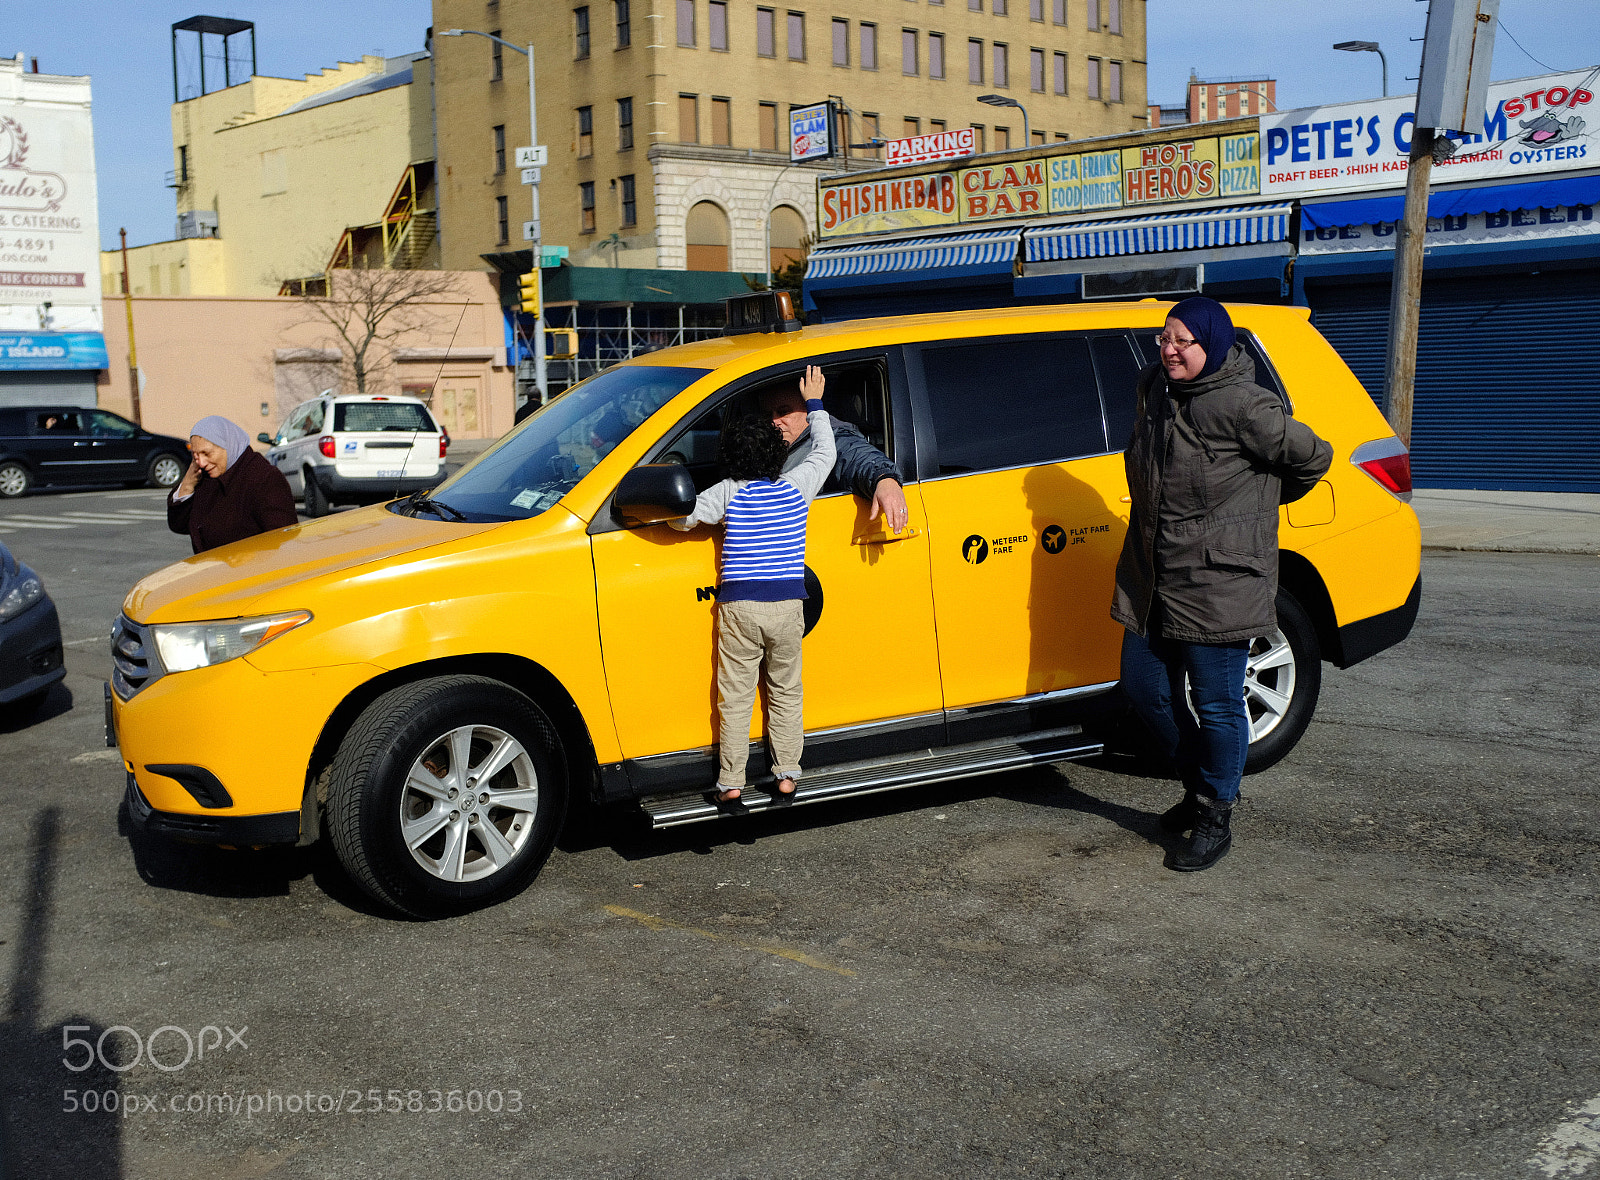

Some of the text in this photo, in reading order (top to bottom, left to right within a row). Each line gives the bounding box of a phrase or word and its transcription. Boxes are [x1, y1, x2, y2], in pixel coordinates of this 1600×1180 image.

[1503, 85, 1595, 119] STOP
[793, 118, 826, 136] CLAM
[1266, 100, 1508, 166] PETE'S CM
[522, 149, 541, 162] ALT
[887, 130, 973, 159] PARKING
[1139, 142, 1195, 168] HOT
[1225, 136, 1255, 163] HOT
[1509, 144, 1588, 165] OYSTERS
[526, 170, 537, 180] TO
[962, 162, 1045, 193] CLAM
[1051, 159, 1079, 182] SEA
[1082, 152, 1120, 180] FRANKS
[1269, 170, 1306, 184] DRAFT
[1309, 167, 1339, 180] BEER
[1346, 163, 1379, 176] SHISH
[1382, 160, 1408, 172] KAB
[0, 176, 56, 197] ulo's
[1125, 160, 1216, 204] HERO'S
[1222, 165, 1259, 193] PIZZA
[966, 189, 1041, 218] BAR
[1051, 184, 1081, 209] FOOD
[1082, 180, 1122, 207] BURGERS
[12, 215, 81, 229] CATERING
[0, 273, 78, 286] HE CORNER
[8, 346, 65, 358] ISLAND
[992, 534, 1028, 546] METERED
[1070, 525, 1110, 537] FLAT FARE
[1071, 537, 1086, 545] JFK
[993, 546, 1013, 555] FARE
